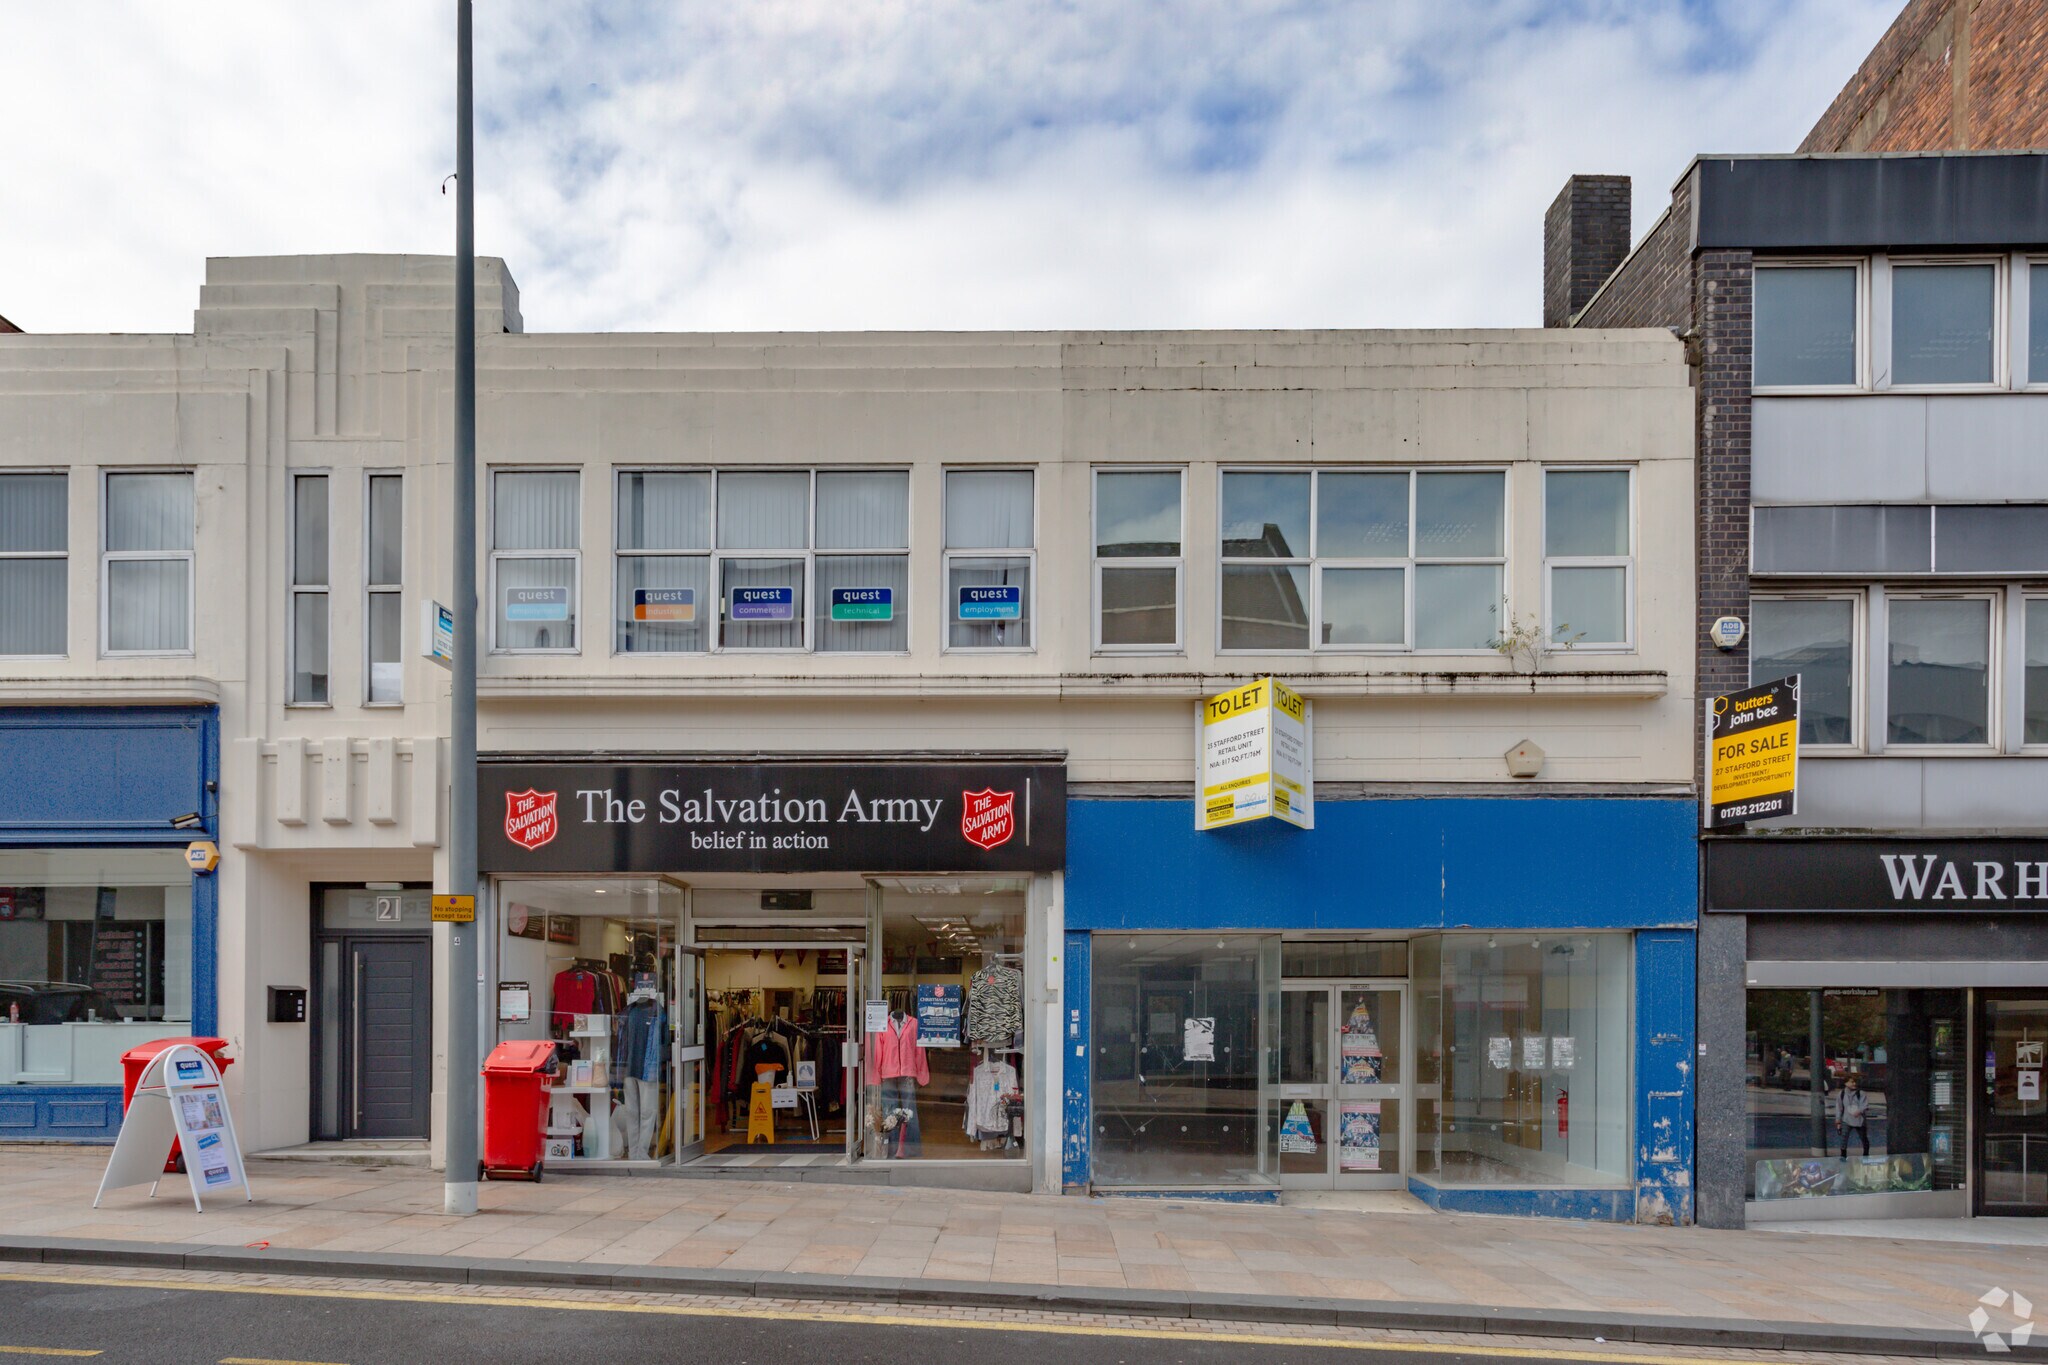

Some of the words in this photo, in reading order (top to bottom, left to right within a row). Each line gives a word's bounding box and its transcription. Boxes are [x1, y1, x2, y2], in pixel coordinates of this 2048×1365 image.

[518, 590, 555, 602] quest
[645, 590, 682, 602] quest
[743, 589, 781, 601] quest
[843, 590, 880, 602] quest
[970, 588, 1008, 601] quest
[645, 607, 683, 616] industrial
[739, 606, 786, 615] commercial
[844, 606, 880, 615] technical
[965, 606, 1014, 616] employment
[1210, 697, 1230, 718] TO
[1234, 686, 1262, 711] LET
[1276, 686, 1287, 706] TO
[1289, 695, 1302, 717] LET
[1735, 693, 1773, 712] butters
[1730, 709, 1754, 728] john
[1757, 705, 1779, 719] bee
[1213, 734, 1242, 748] STAFFORD
[1242, 727, 1265, 739] STREET
[1718, 743, 1745, 762] FOR
[1750, 732, 1789, 754] SALE
[1218, 745, 1237, 756] RETAIL
[1238, 740, 1253, 750] UNIT
[1715, 767, 1724, 776] 27
[1725, 760, 1761, 774] STAFFORD
[1762, 753, 1792, 768] STREET
[1713, 778, 1751, 792] DEVELOPMENT
[1752, 771, 1792, 784] OPPORTUNITY
[516, 795, 535, 812] THE
[576, 789, 646, 824] The
[659, 788, 829, 824] Salvation
[837, 790, 943, 832] Army
[973, 795, 992, 812] THE
[1720, 803, 1747, 819] 01782
[1748, 799, 1782, 814] 212201
[508, 799, 554, 836] SALVATION
[964, 798, 1011, 836] SALVATION
[524, 818, 551, 843] ARMY
[980, 818, 1008, 842] ARMY
[691, 830, 744, 850] belief
[749, 831, 767, 850] in
[772, 831, 829, 850] action
[191, 851, 205, 859] ADT
[378, 898, 399, 920] 21
[180, 1061, 198, 1070] quest
